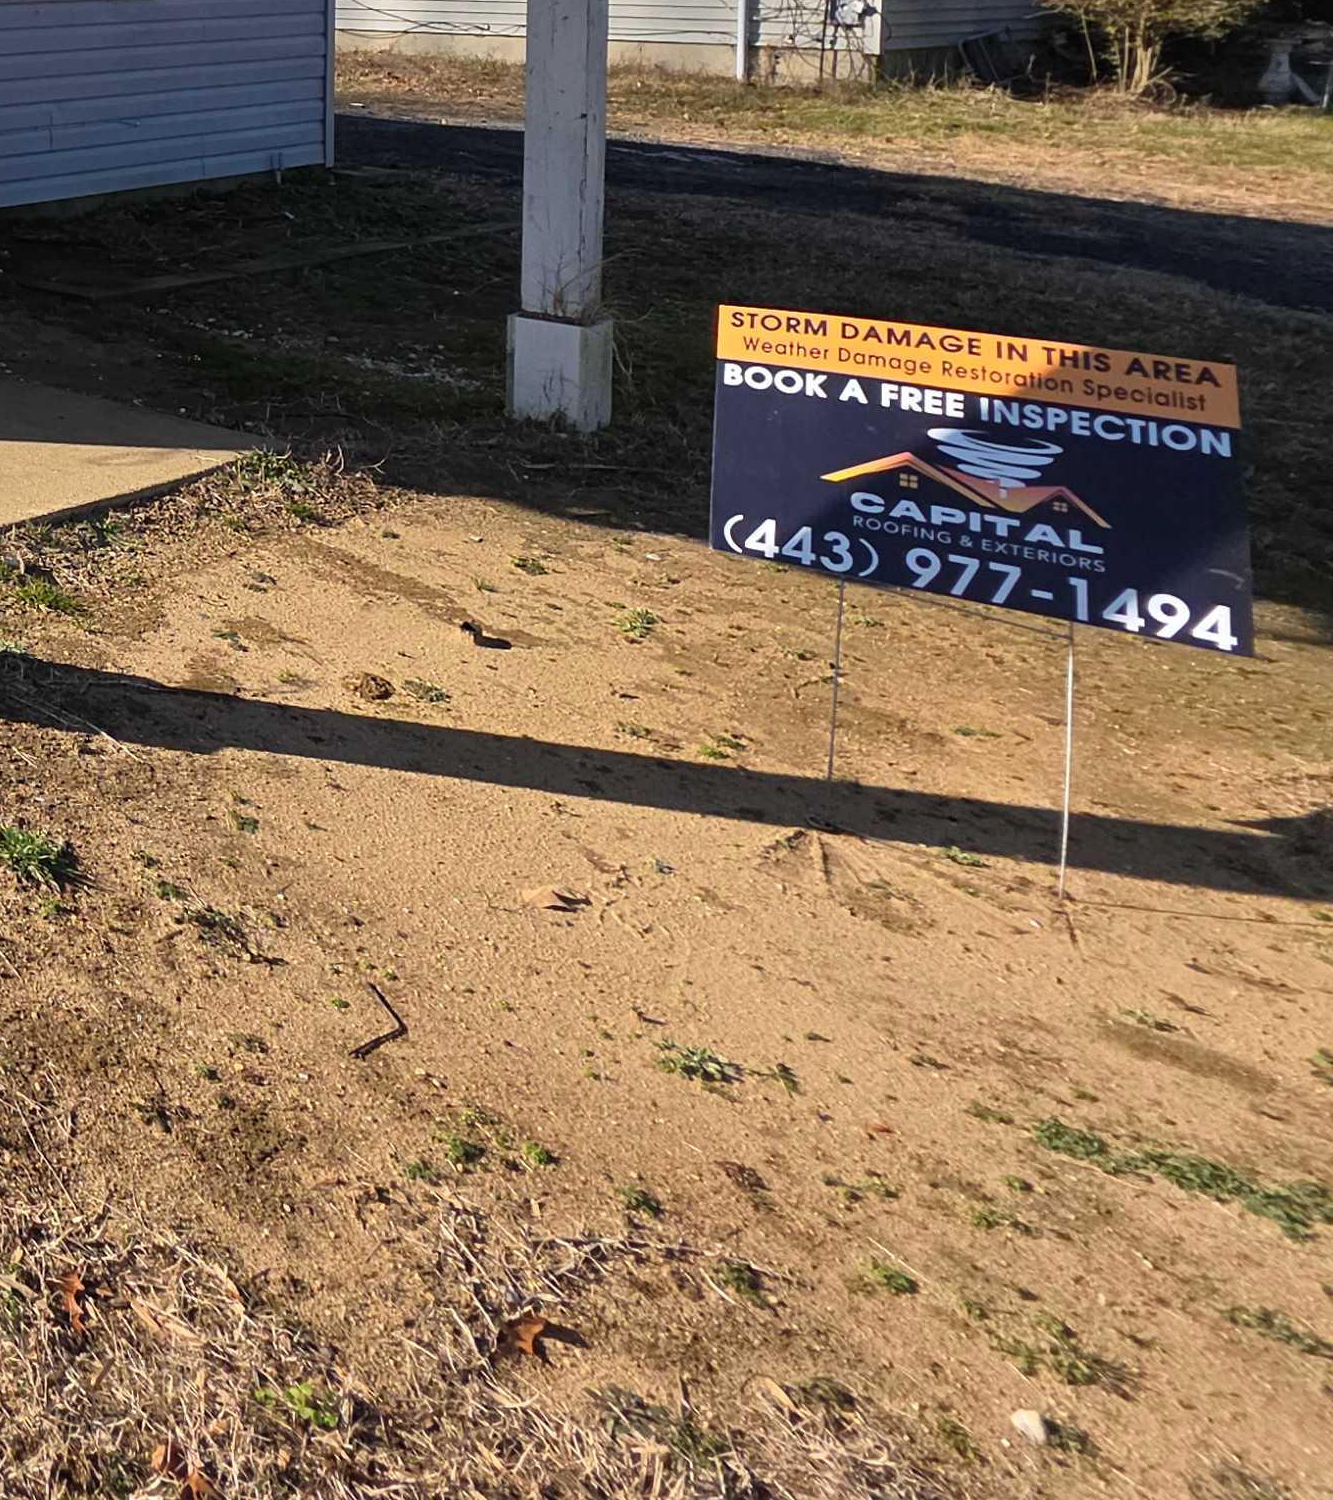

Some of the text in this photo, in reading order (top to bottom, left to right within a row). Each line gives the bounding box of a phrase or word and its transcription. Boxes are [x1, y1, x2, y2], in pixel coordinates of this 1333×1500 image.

[731, 312, 1222, 388] STORM DAMAGE IN THIS AREA
[743, 336, 1207, 411] Weather Damage Restoration Specialist
[723, 363, 1233, 457] BOOK A FREE INSPECTION
[849, 491, 1104, 554] CAPITAL
[852, 515, 1106, 573] ROOFING & EXTERIORS
[723, 514, 1238, 651] (443) 977-1494
